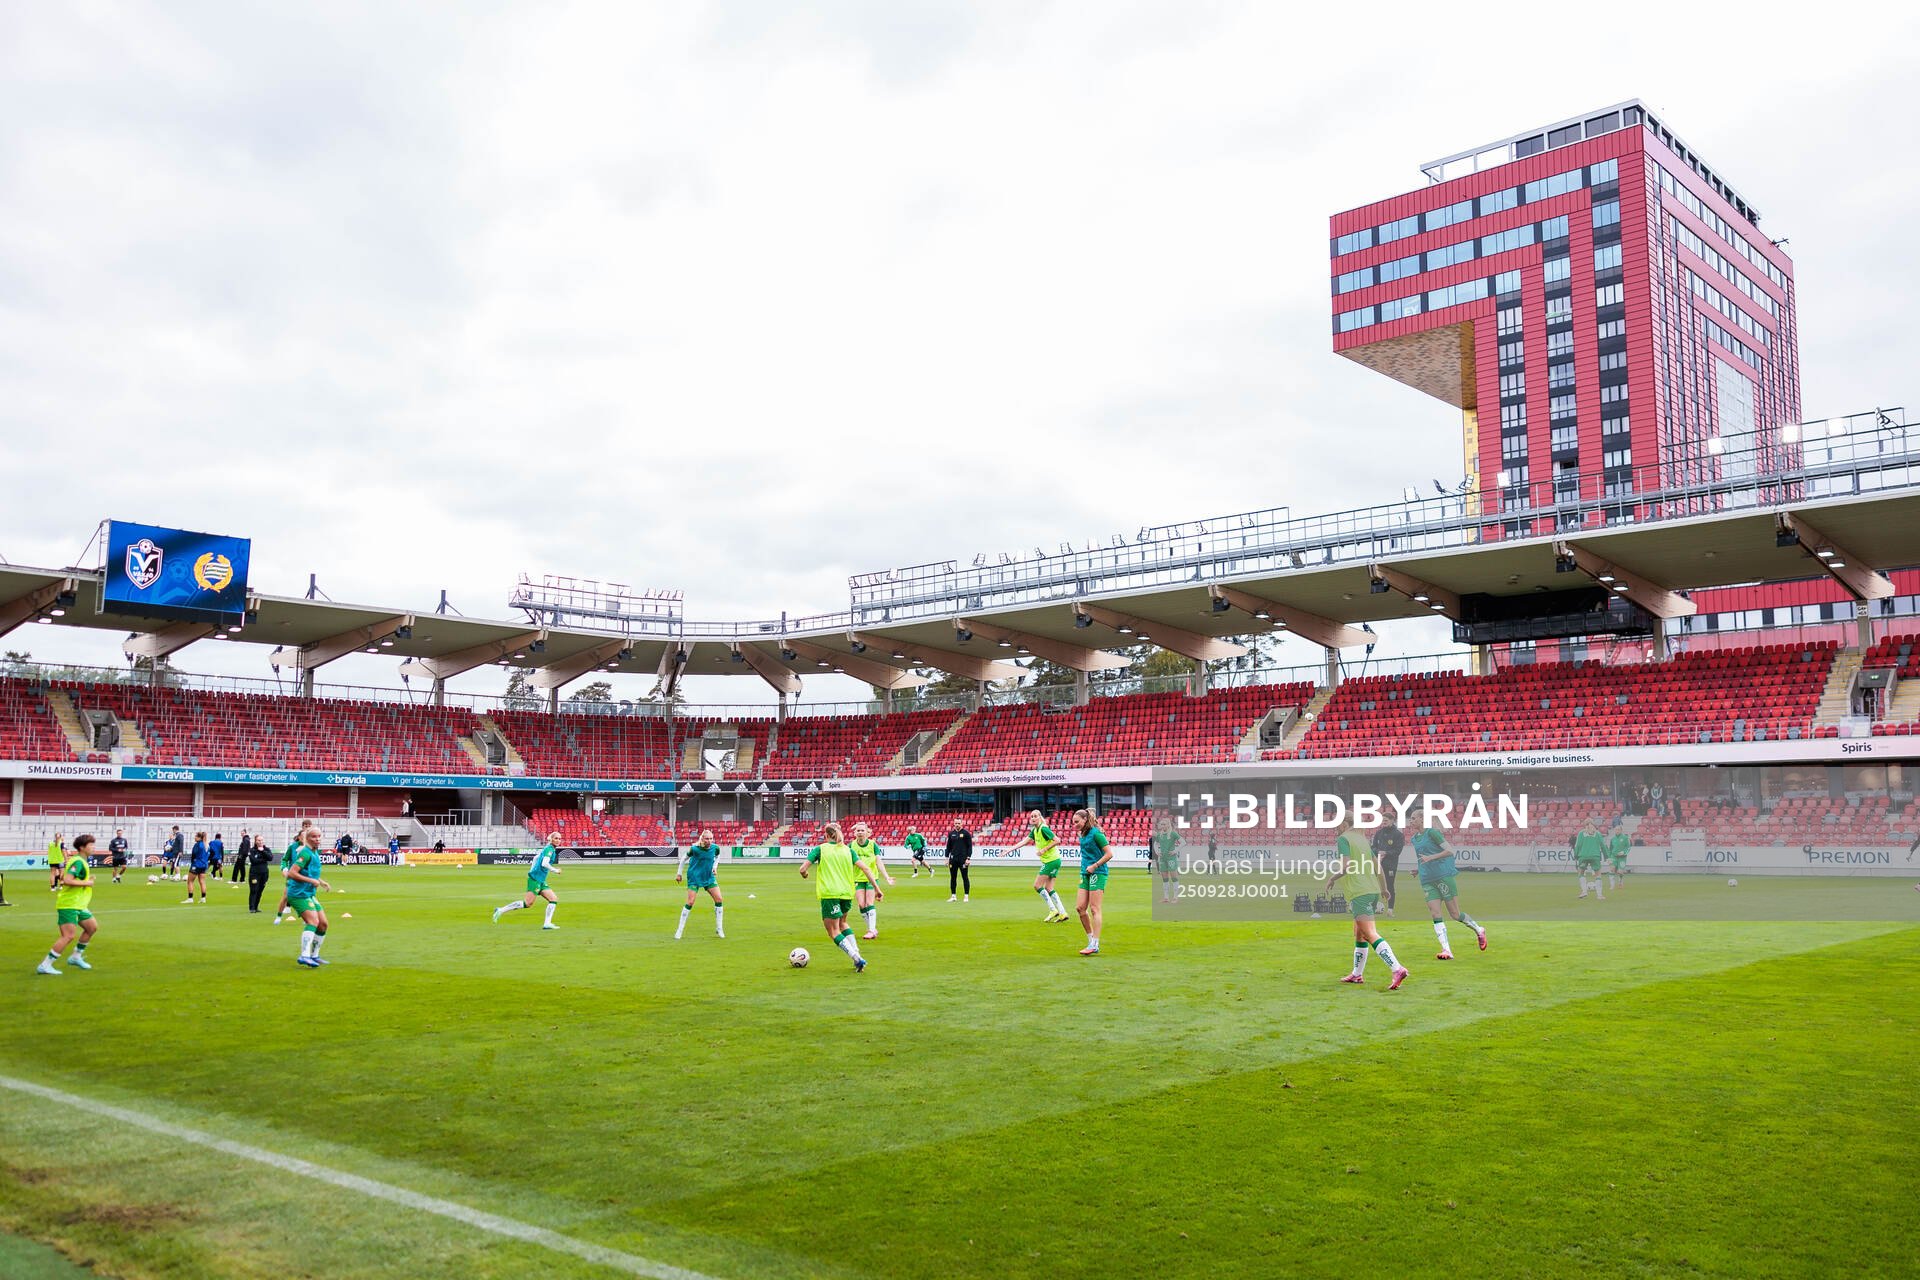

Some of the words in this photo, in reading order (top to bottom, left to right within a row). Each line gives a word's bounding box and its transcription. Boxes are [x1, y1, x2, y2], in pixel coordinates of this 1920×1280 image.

[1842, 742, 1872, 754] Spiris
[1416, 759, 1453, 767] Smartare
[1455, 757, 1505, 767] fakturering.
[1507, 755, 1550, 766] Smidigare
[1552, 754, 1594, 763] business.
[28, 764, 112, 776] SMÅLANDSPOSTEN
[157, 769, 194, 780] bravida
[224, 771, 233, 779] Vi
[234, 773, 247, 781] ger
[249, 771, 287, 782] fastigheter
[1213, 768, 1231, 776] Spiris
[335, 774, 366, 785] bravida
[486, 779, 514, 788] bravida
[1012, 774, 1040, 783] Smidigare
[1041, 773, 1066, 781] business.
[626, 782, 655, 791] bravida
[1808, 851, 1890, 864] PREMON
